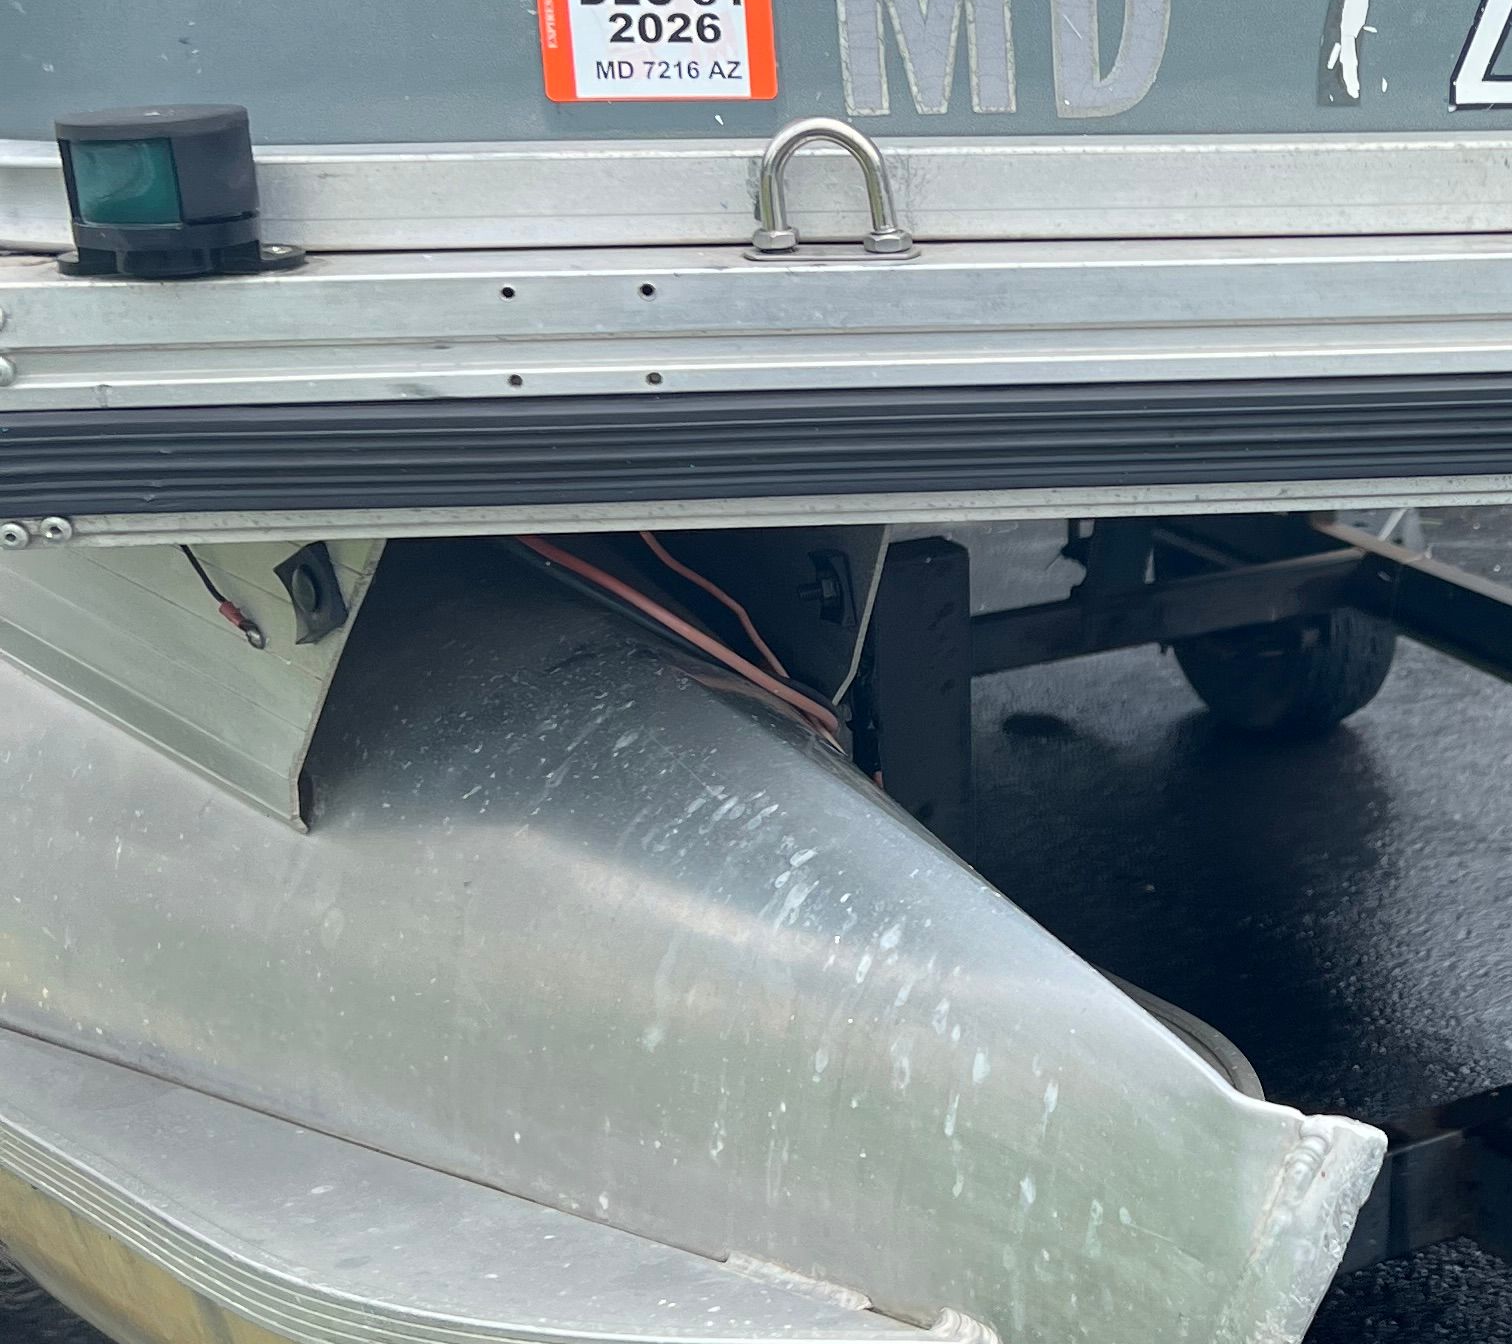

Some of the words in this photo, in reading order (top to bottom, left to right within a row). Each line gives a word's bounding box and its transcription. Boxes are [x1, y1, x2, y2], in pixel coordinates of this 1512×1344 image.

[609, 12, 722, 43] 2026
[596, 61, 634, 80] MD
[645, 60, 700, 80] 7216
[708, 61, 743, 80] AZ
